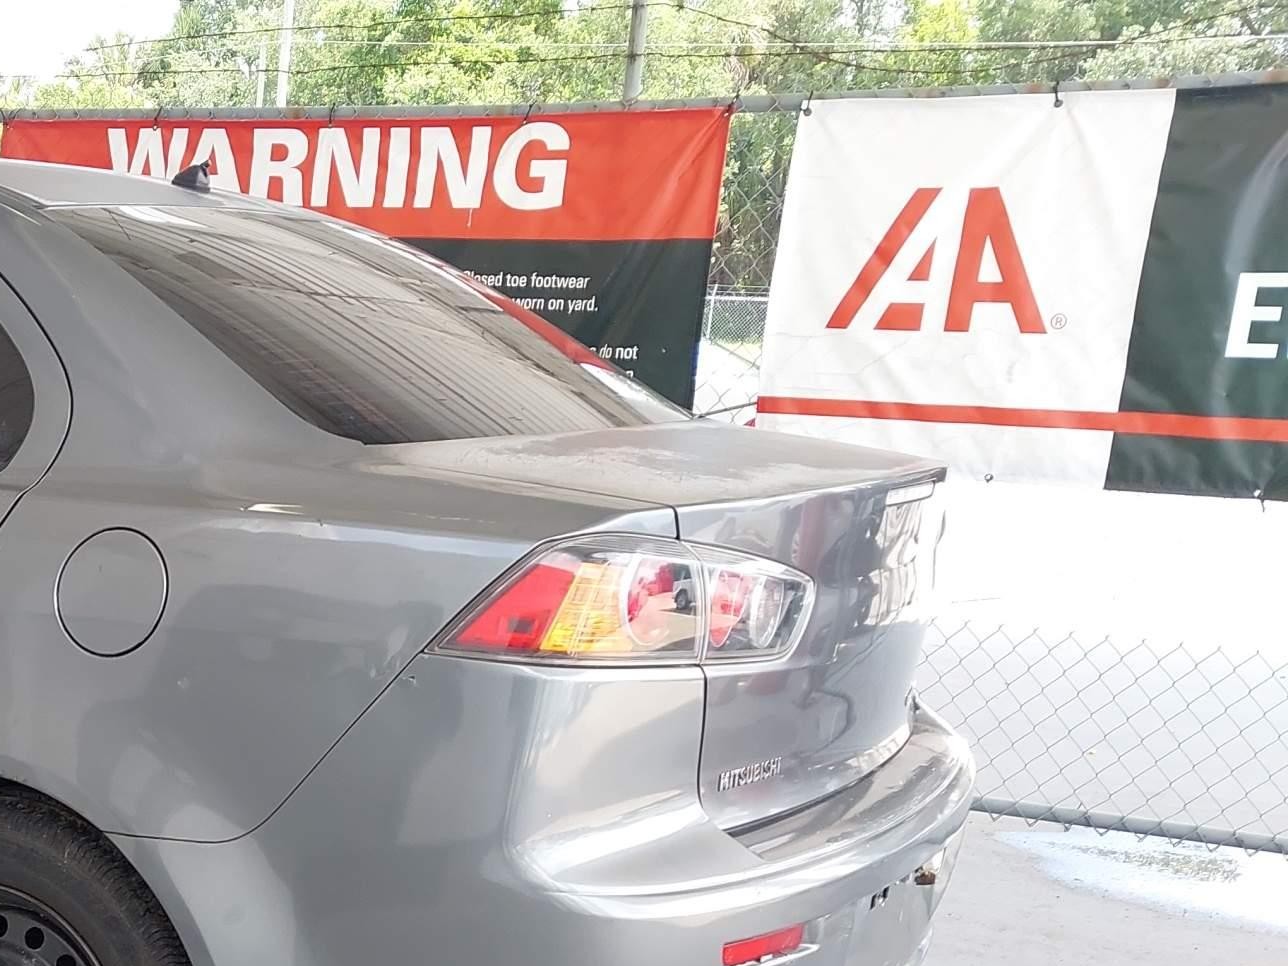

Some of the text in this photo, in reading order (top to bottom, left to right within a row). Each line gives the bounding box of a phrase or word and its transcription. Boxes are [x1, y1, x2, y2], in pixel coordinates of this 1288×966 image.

[106, 121, 571, 210] WARNING
[506, 273, 527, 287] toe
[531, 272, 591, 288] footwear
[512, 295, 598, 314] worn on yard.
[599, 343, 639, 360] do not
[717, 756, 782, 792] MITSUBISHI
